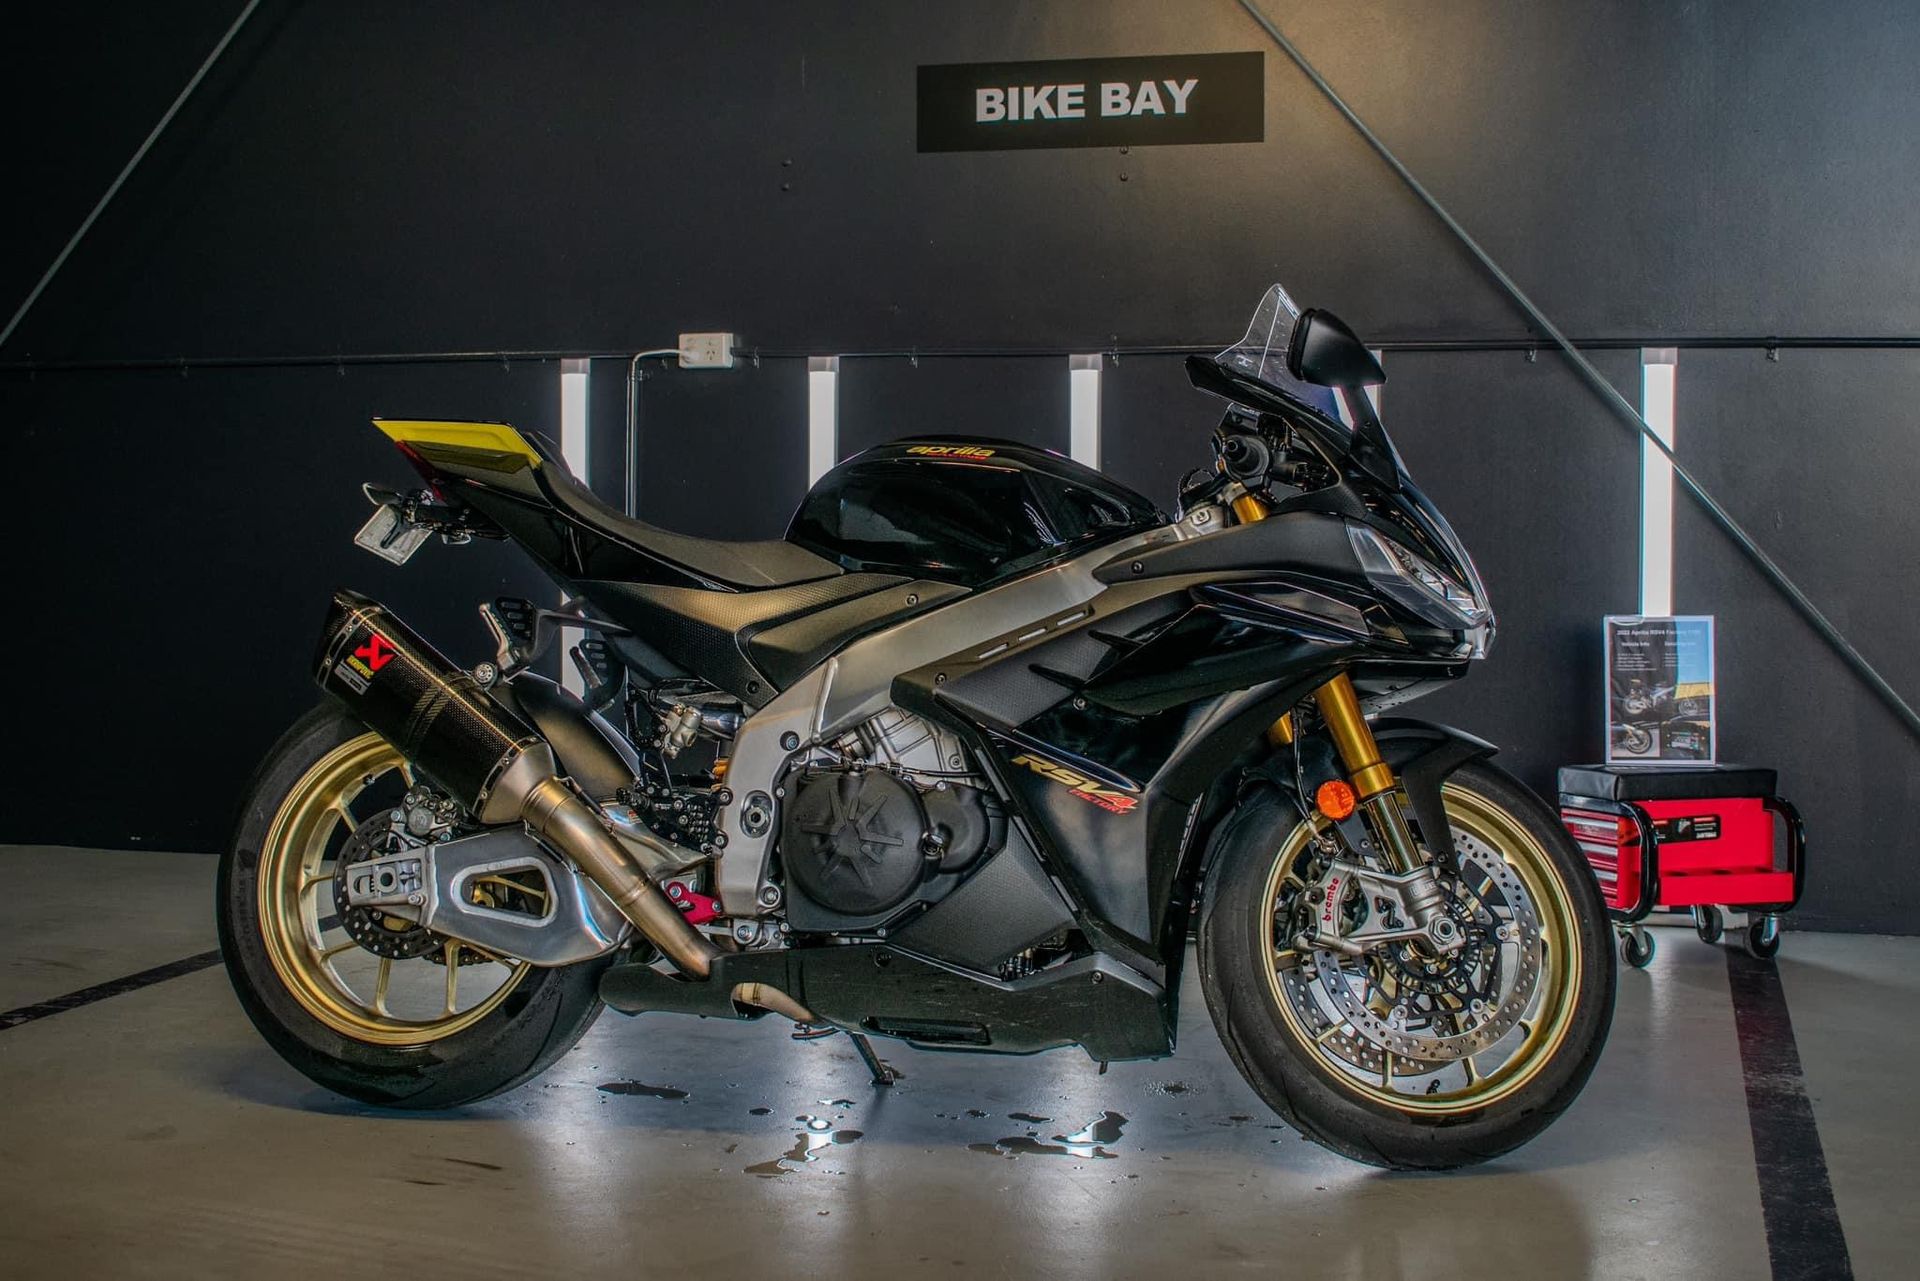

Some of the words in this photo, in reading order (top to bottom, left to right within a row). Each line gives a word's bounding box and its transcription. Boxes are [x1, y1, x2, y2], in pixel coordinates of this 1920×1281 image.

[975, 83, 1087, 123] BIKE
[1100, 78, 1200, 118] BAY
[906, 445, 996, 457] aprilia
[1011, 752, 1139, 810] RSV4
[1322, 877, 1339, 921] brembo
